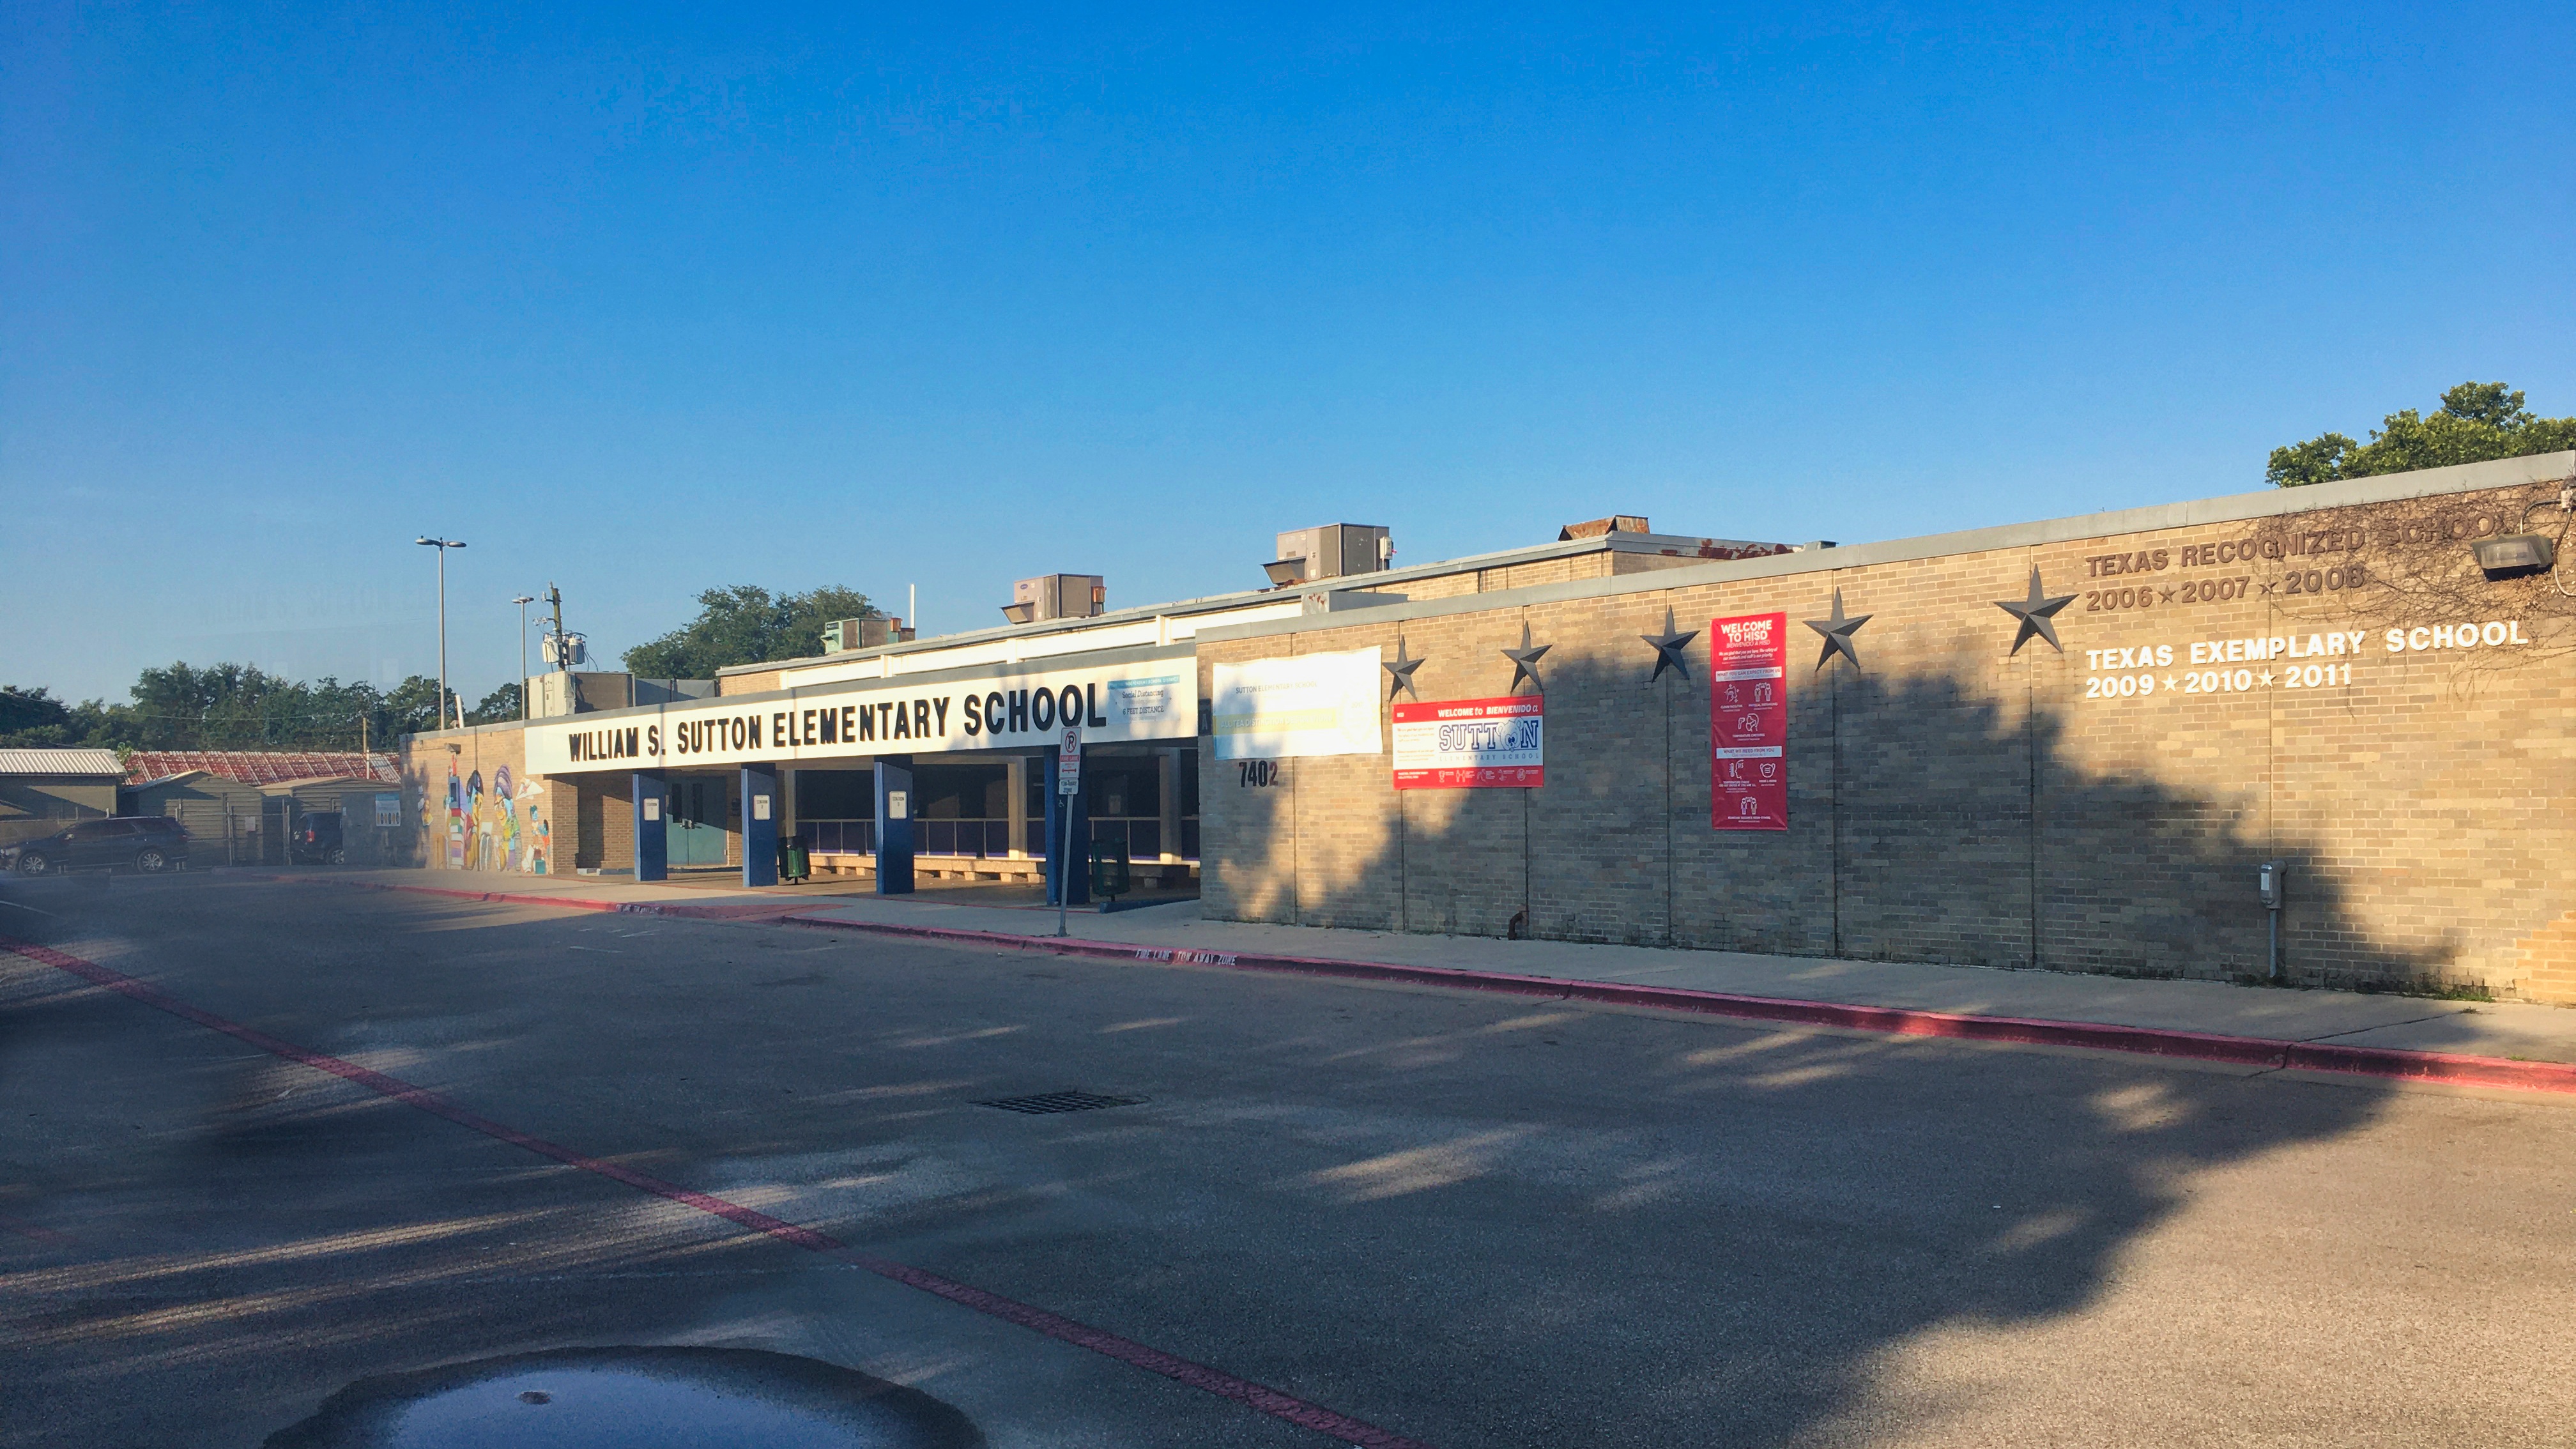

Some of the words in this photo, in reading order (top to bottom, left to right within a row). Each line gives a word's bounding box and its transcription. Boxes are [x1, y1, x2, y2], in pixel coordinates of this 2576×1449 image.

[2085, 549, 2170, 578] TEXAS
[2181, 526, 2365, 567] RECOGNIZED
[2085, 586, 2153, 611] 2006
[2181, 576, 2250, 604] 2007
[2285, 566, 2365, 595] 2008
[1721, 620, 1772, 634] WELCOME
[1728, 633, 1742, 643] TO
[1744, 630, 1768, 642] HISD
[2085, 644, 2174, 671] TEXAS
[2189, 630, 2366, 665] EXEMPLARY
[2385, 620, 2529, 653] SCHOOL
[1236, 683, 1257, 694] SUTTON
[1258, 683, 1293, 693] ELEMENTARY
[2085, 673, 2155, 699] 2009
[2184, 668, 2253, 694] 2010
[2284, 663, 2352, 689] 2011
[1122, 690, 1137, 698] Social
[1137, 689, 1164, 698] Distancing
[1139, 705, 1164, 714] DISTANCE
[1438, 707, 1473, 717] WELCOME
[1475, 707, 1483, 716] to
[1486, 704, 1531, 715] BIENVENIDO
[568, 726, 640, 762] WILLIAM
[647, 724, 666, 756] S.
[677, 714, 762, 755] SUTTON
[773, 696, 951, 747] ELEMENTARY
[963, 682, 1107, 736] SCHOOL
[1221, 720, 1232, 728] ALL
[1234, 718, 1244, 728] TEA
[1245, 716, 1285, 727] DISTINCTION
[1439, 719, 1539, 751] SUTTN
[1238, 760, 1278, 788] 7402
[1135, 948, 1151, 959] FIRE
[1153, 949, 1172, 961] LANE
[1177, 951, 1192, 962] TOW
[1193, 952, 1215, 963] AWAY
[1217, 954, 1238, 965] ZONE
